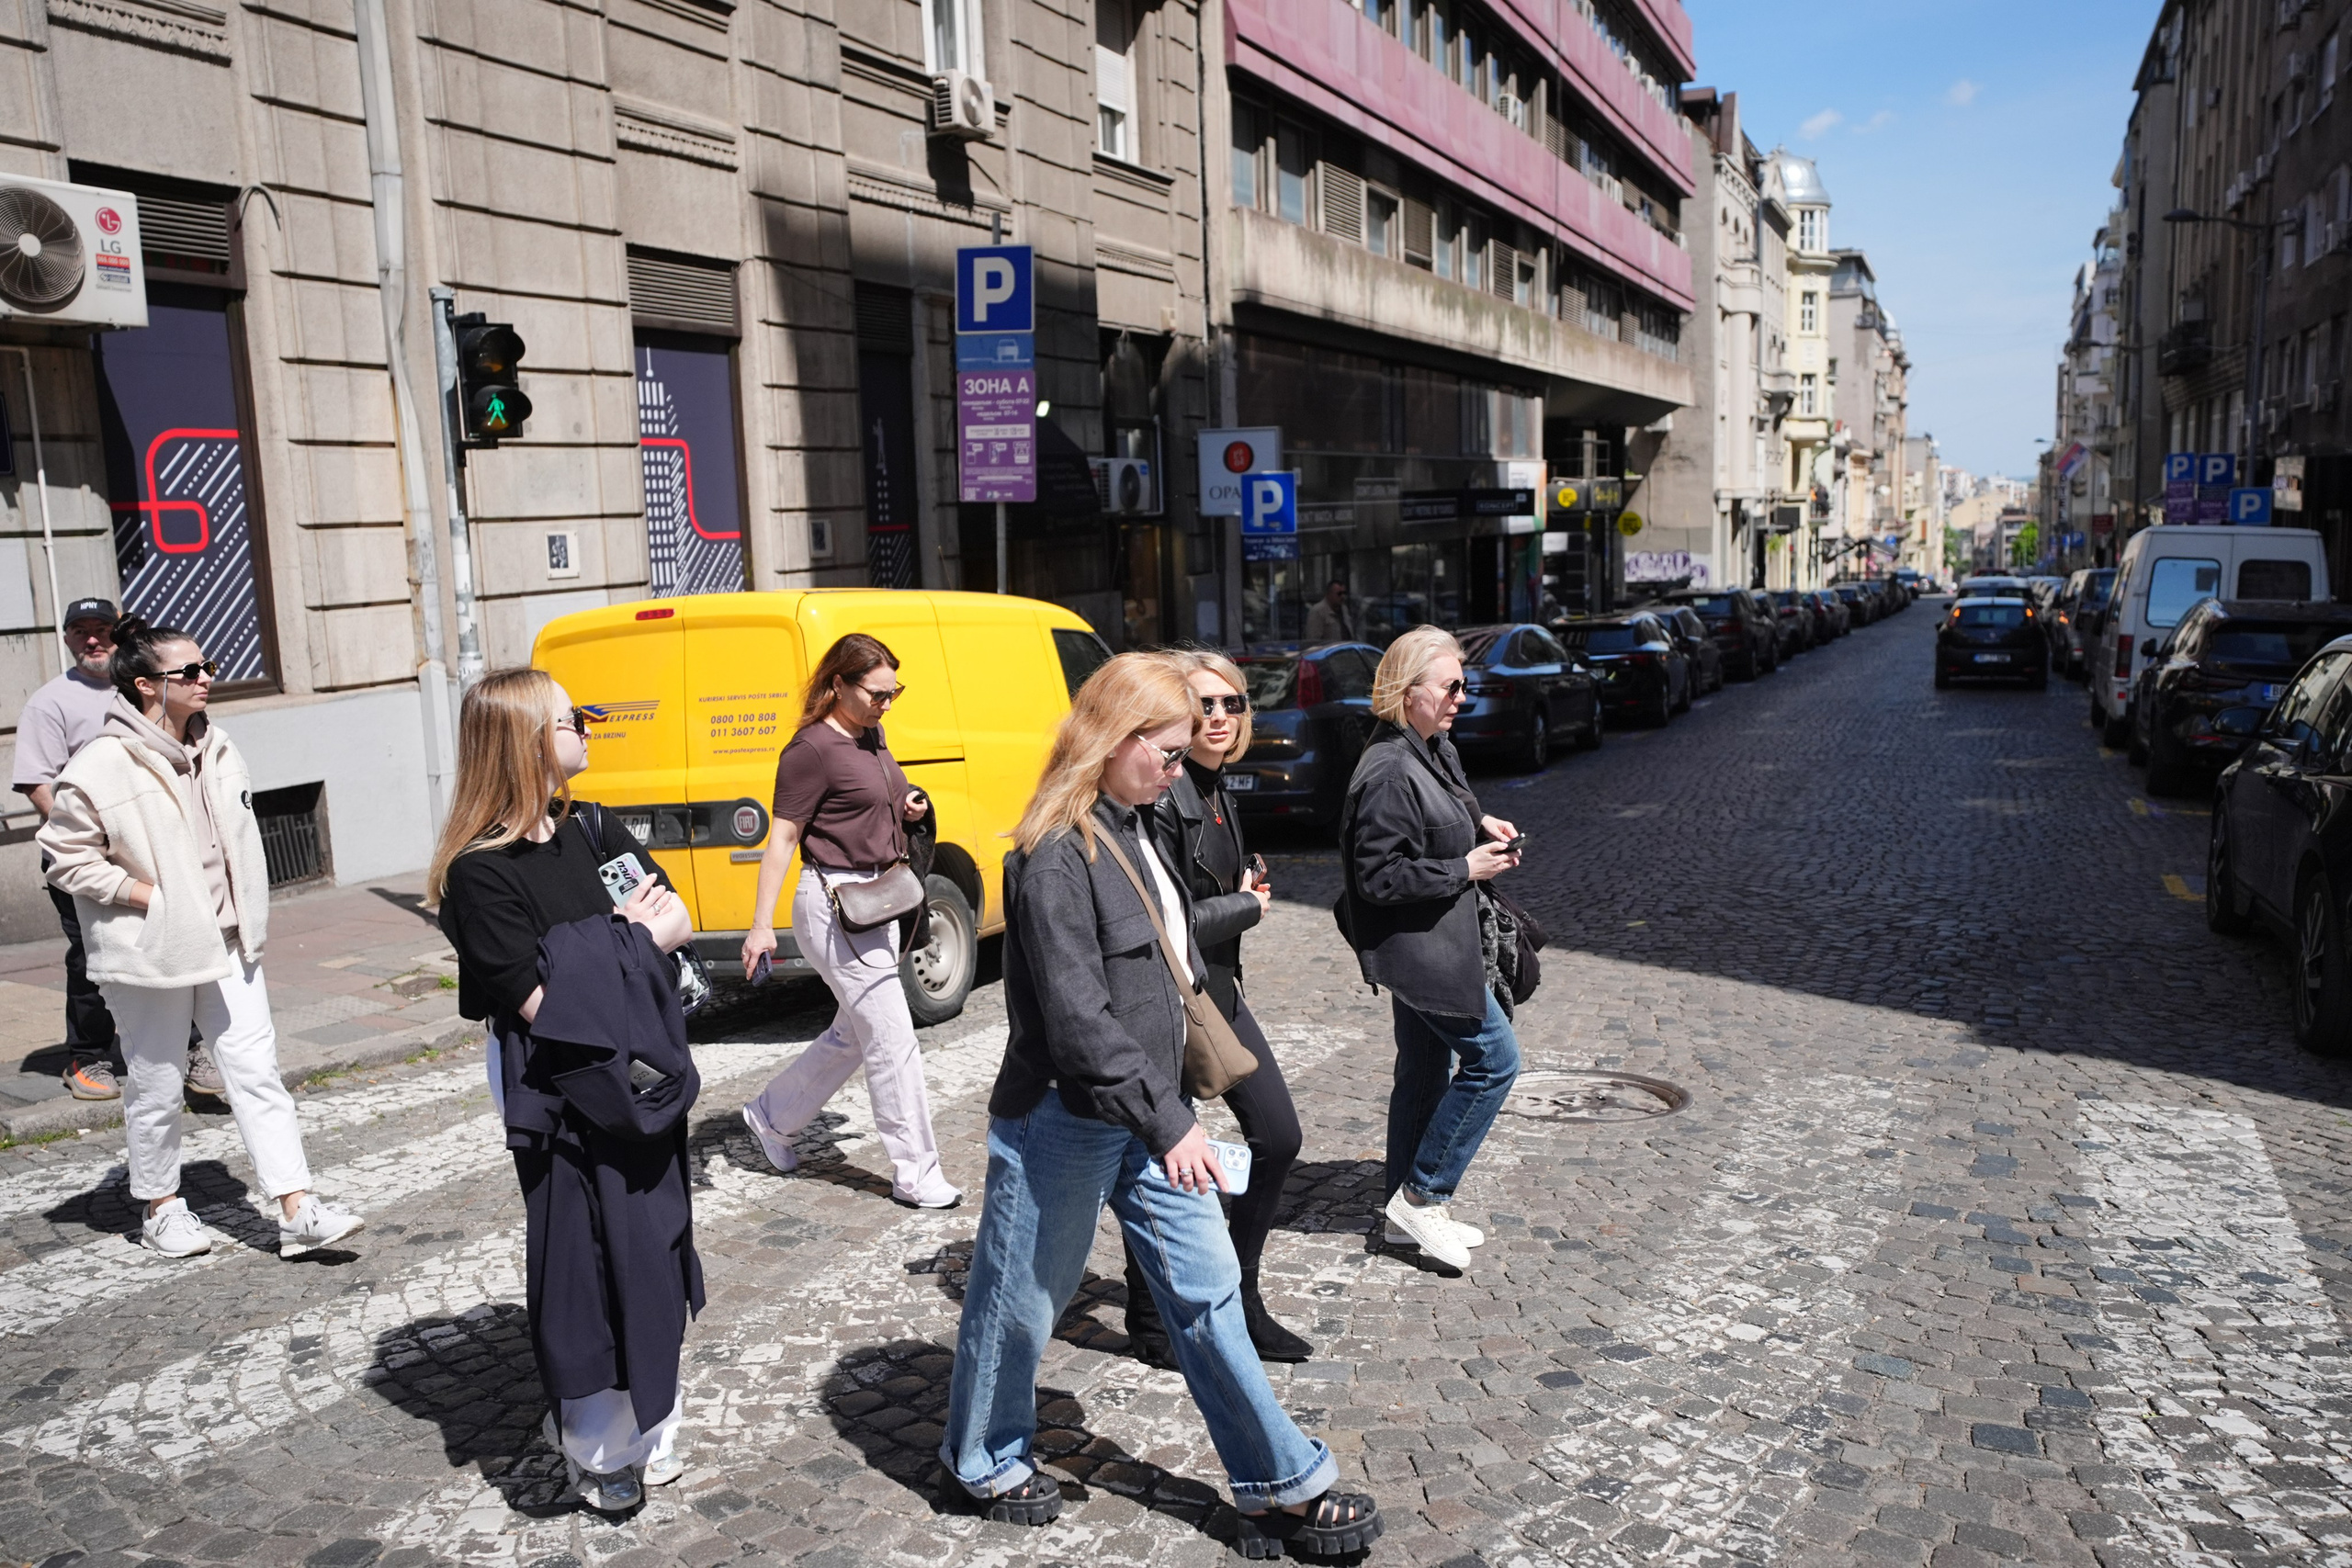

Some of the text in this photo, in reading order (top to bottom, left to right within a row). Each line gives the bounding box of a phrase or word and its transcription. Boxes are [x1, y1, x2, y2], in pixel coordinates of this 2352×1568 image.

[100, 239, 121, 254] LG
[973, 256, 1015, 321] P
[964, 377, 1030, 395] ЗОНА А
[2172, 456, 2189, 478] P
[2206, 457, 2228, 482] P
[1209, 486, 1241, 499] OPA
[1252, 480, 1283, 526] P
[2239, 493, 2261, 520] P
[80, 602, 97, 610] HPNY
[609, 713, 655, 723] EXPRESS
[710, 712, 776, 724] 0800 100 808
[603, 731, 626, 739] BRZINU
[710, 726, 776, 738] 011 3607 607
[713, 747, 775, 755] www.postexpress.rs
[739, 815, 753, 829] FIAT
[732, 852, 764, 860] PROFESSION
